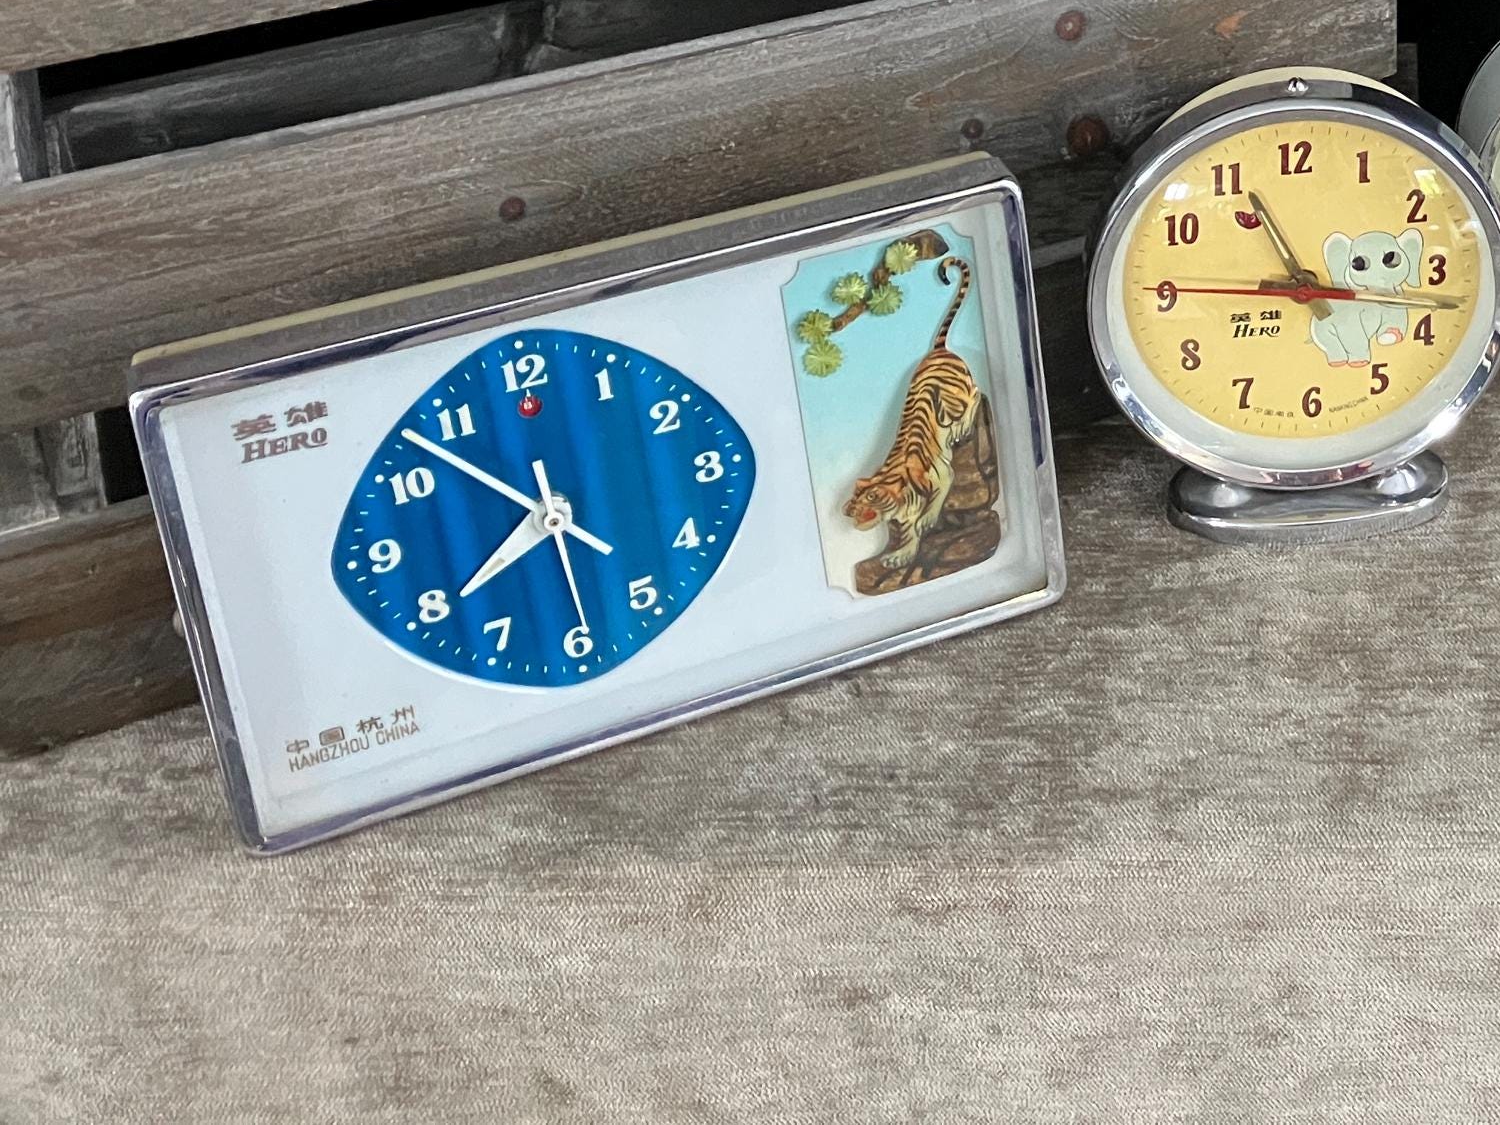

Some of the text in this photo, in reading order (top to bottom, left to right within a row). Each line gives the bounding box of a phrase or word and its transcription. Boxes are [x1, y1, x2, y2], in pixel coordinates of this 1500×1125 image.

[1278, 141, 1313, 176] 12
[1357, 151, 1371, 184] 1
[1212, 163, 1242, 197] 11
[1406, 190, 1428, 223] 2
[1165, 213, 1199, 246] 10
[1428, 255, 1446, 286] 3
[1156, 280, 1177, 312] 9
[1232, 323, 1281, 338] HERO
[1413, 314, 1435, 346] 4
[1180, 339, 1201, 370] 8
[501, 354, 548, 393] 12
[595, 368, 614, 401] 1
[1370, 364, 1390, 395] 5
[1232, 377, 1254, 410] 7
[1302, 387, 1322, 418] 6
[233, 400, 329, 441] 英雄
[437, 403, 476, 441] 11
[649, 399, 680, 435] 2
[241, 427, 328, 464] HERO
[694, 450, 724, 482] 3
[388, 467, 435, 505] 10
[672, 518, 700, 549] 4
[369, 538, 401, 573] 9
[418, 589, 450, 623] 8
[628, 576, 657, 610] 5
[483, 617, 511, 651] 7
[563, 626, 593, 657] 6
[286, 704, 415, 755] 中国杭州
[288, 720, 421, 773] HANGZHOU CHINA
